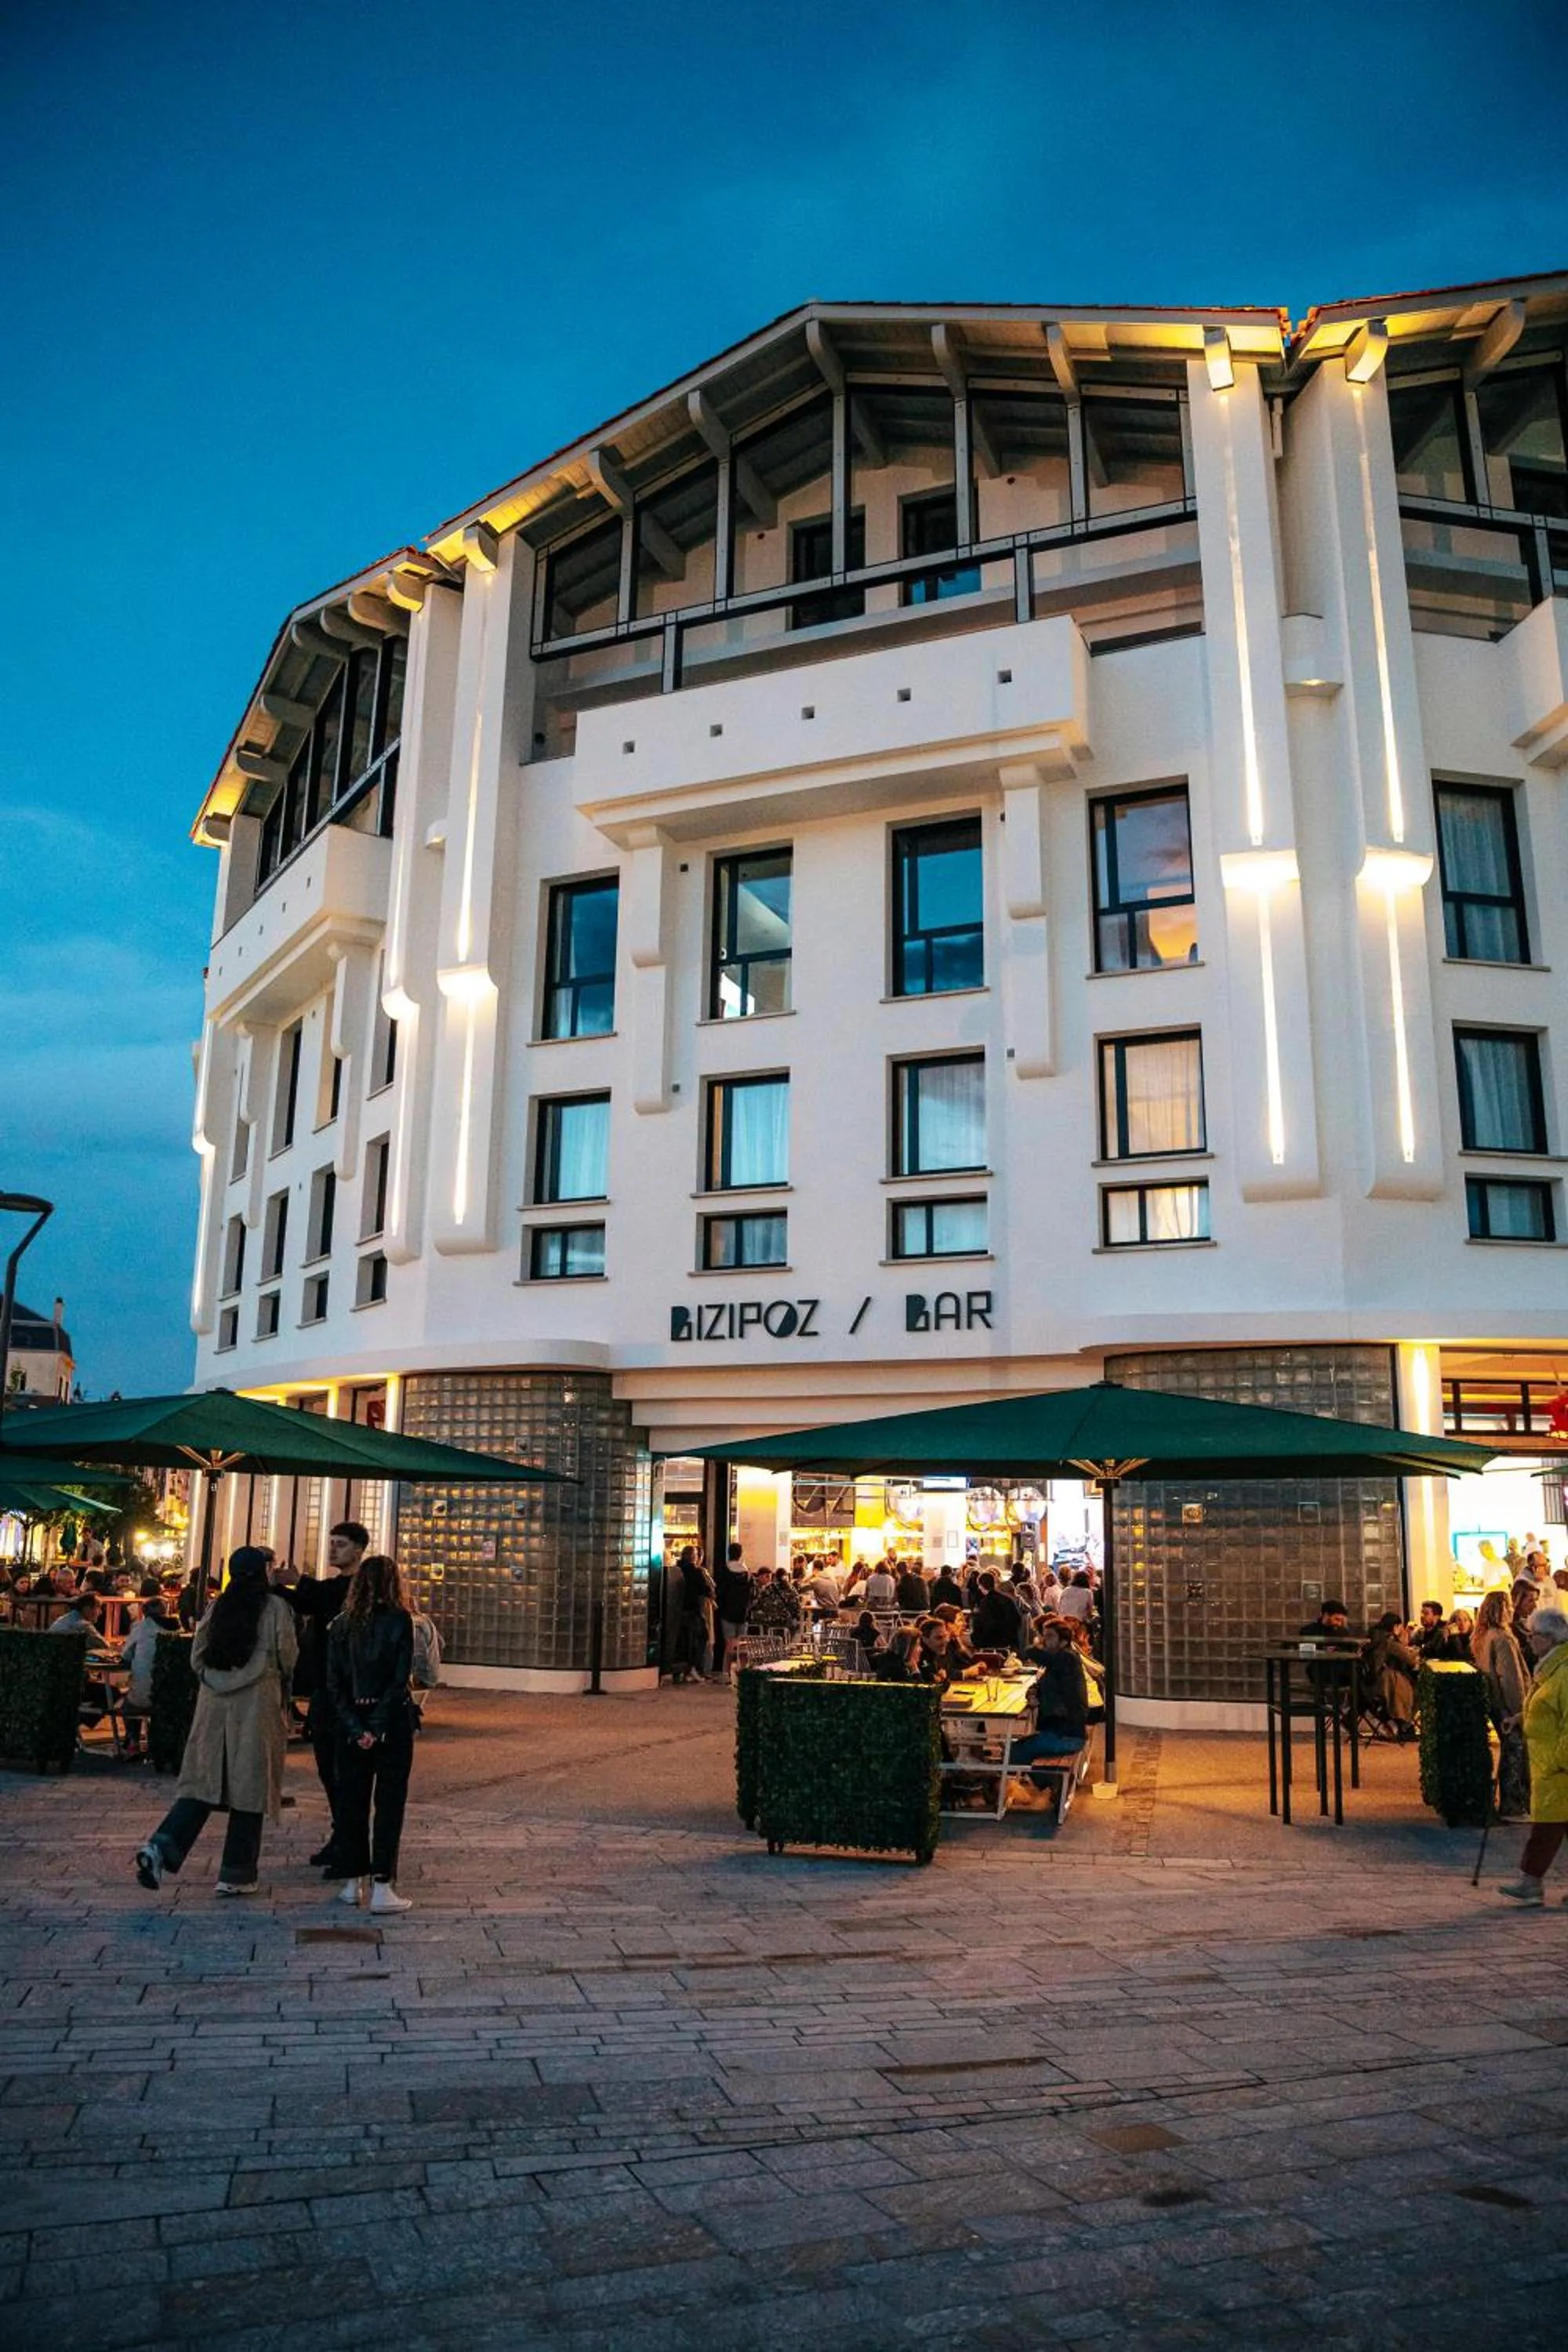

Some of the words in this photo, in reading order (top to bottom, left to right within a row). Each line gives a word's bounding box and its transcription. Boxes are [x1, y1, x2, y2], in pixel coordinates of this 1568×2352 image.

[670, 1299, 820, 1342] BIZIPOZ
[848, 1296, 872, 1335] /
[906, 1290, 993, 1333] BAR
